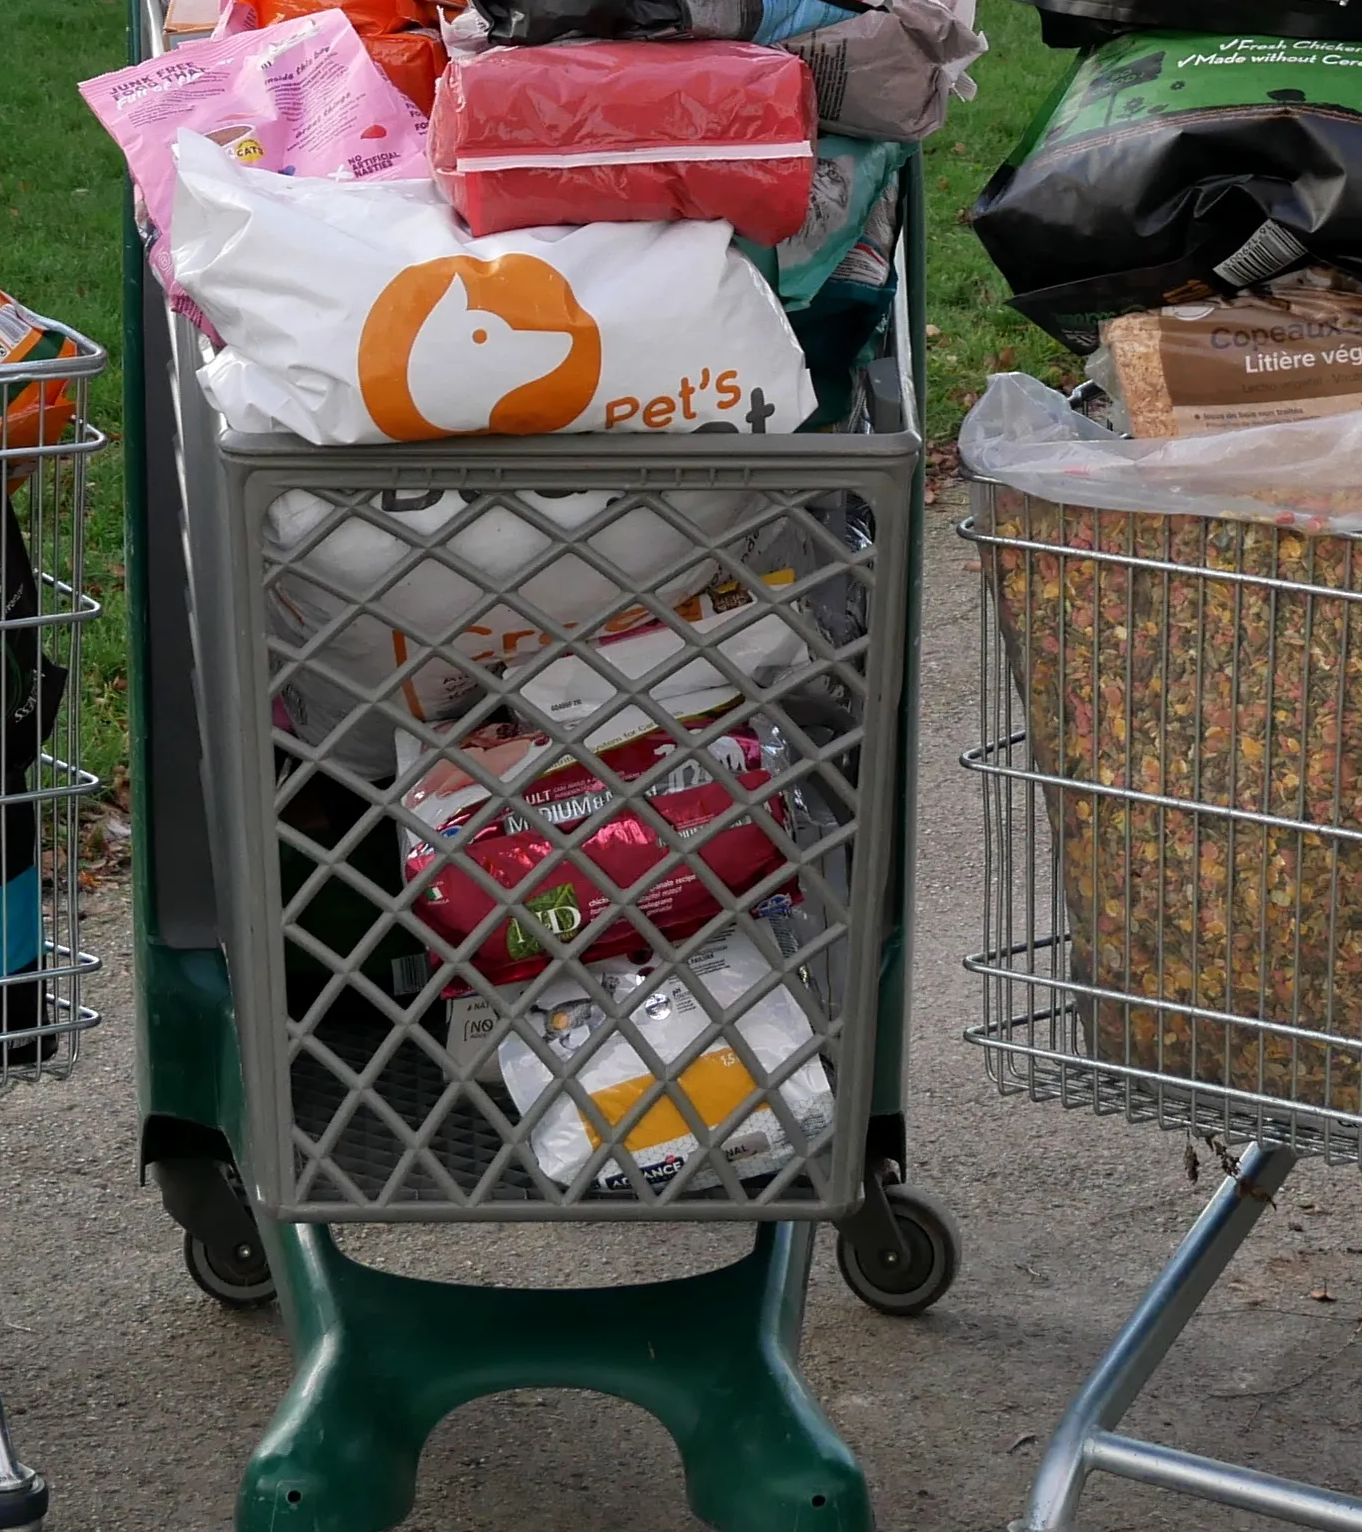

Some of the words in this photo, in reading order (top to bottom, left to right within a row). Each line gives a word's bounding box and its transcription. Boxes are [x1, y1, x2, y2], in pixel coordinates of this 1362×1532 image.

[1238, 39, 1287, 52] Fresh
[1196, 53, 1247, 66] Made
[1251, 52, 1317, 66] without
[110, 75, 154, 96] JUNK
[156, 61, 198, 77] FREE
[112, 81, 159, 102] FOOD
[347, 155, 363, 166] NO
[352, 151, 401, 171] ARTIFICIAL
[354, 160, 394, 179] NASTIES
[1210, 320, 1341, 352] Copeaux
[1244, 349, 1316, 374] Litière
[605, 367, 742, 430] Pet's
[526, 789, 551, 806] ULT
[507, 797, 591, 835] MDIUM
